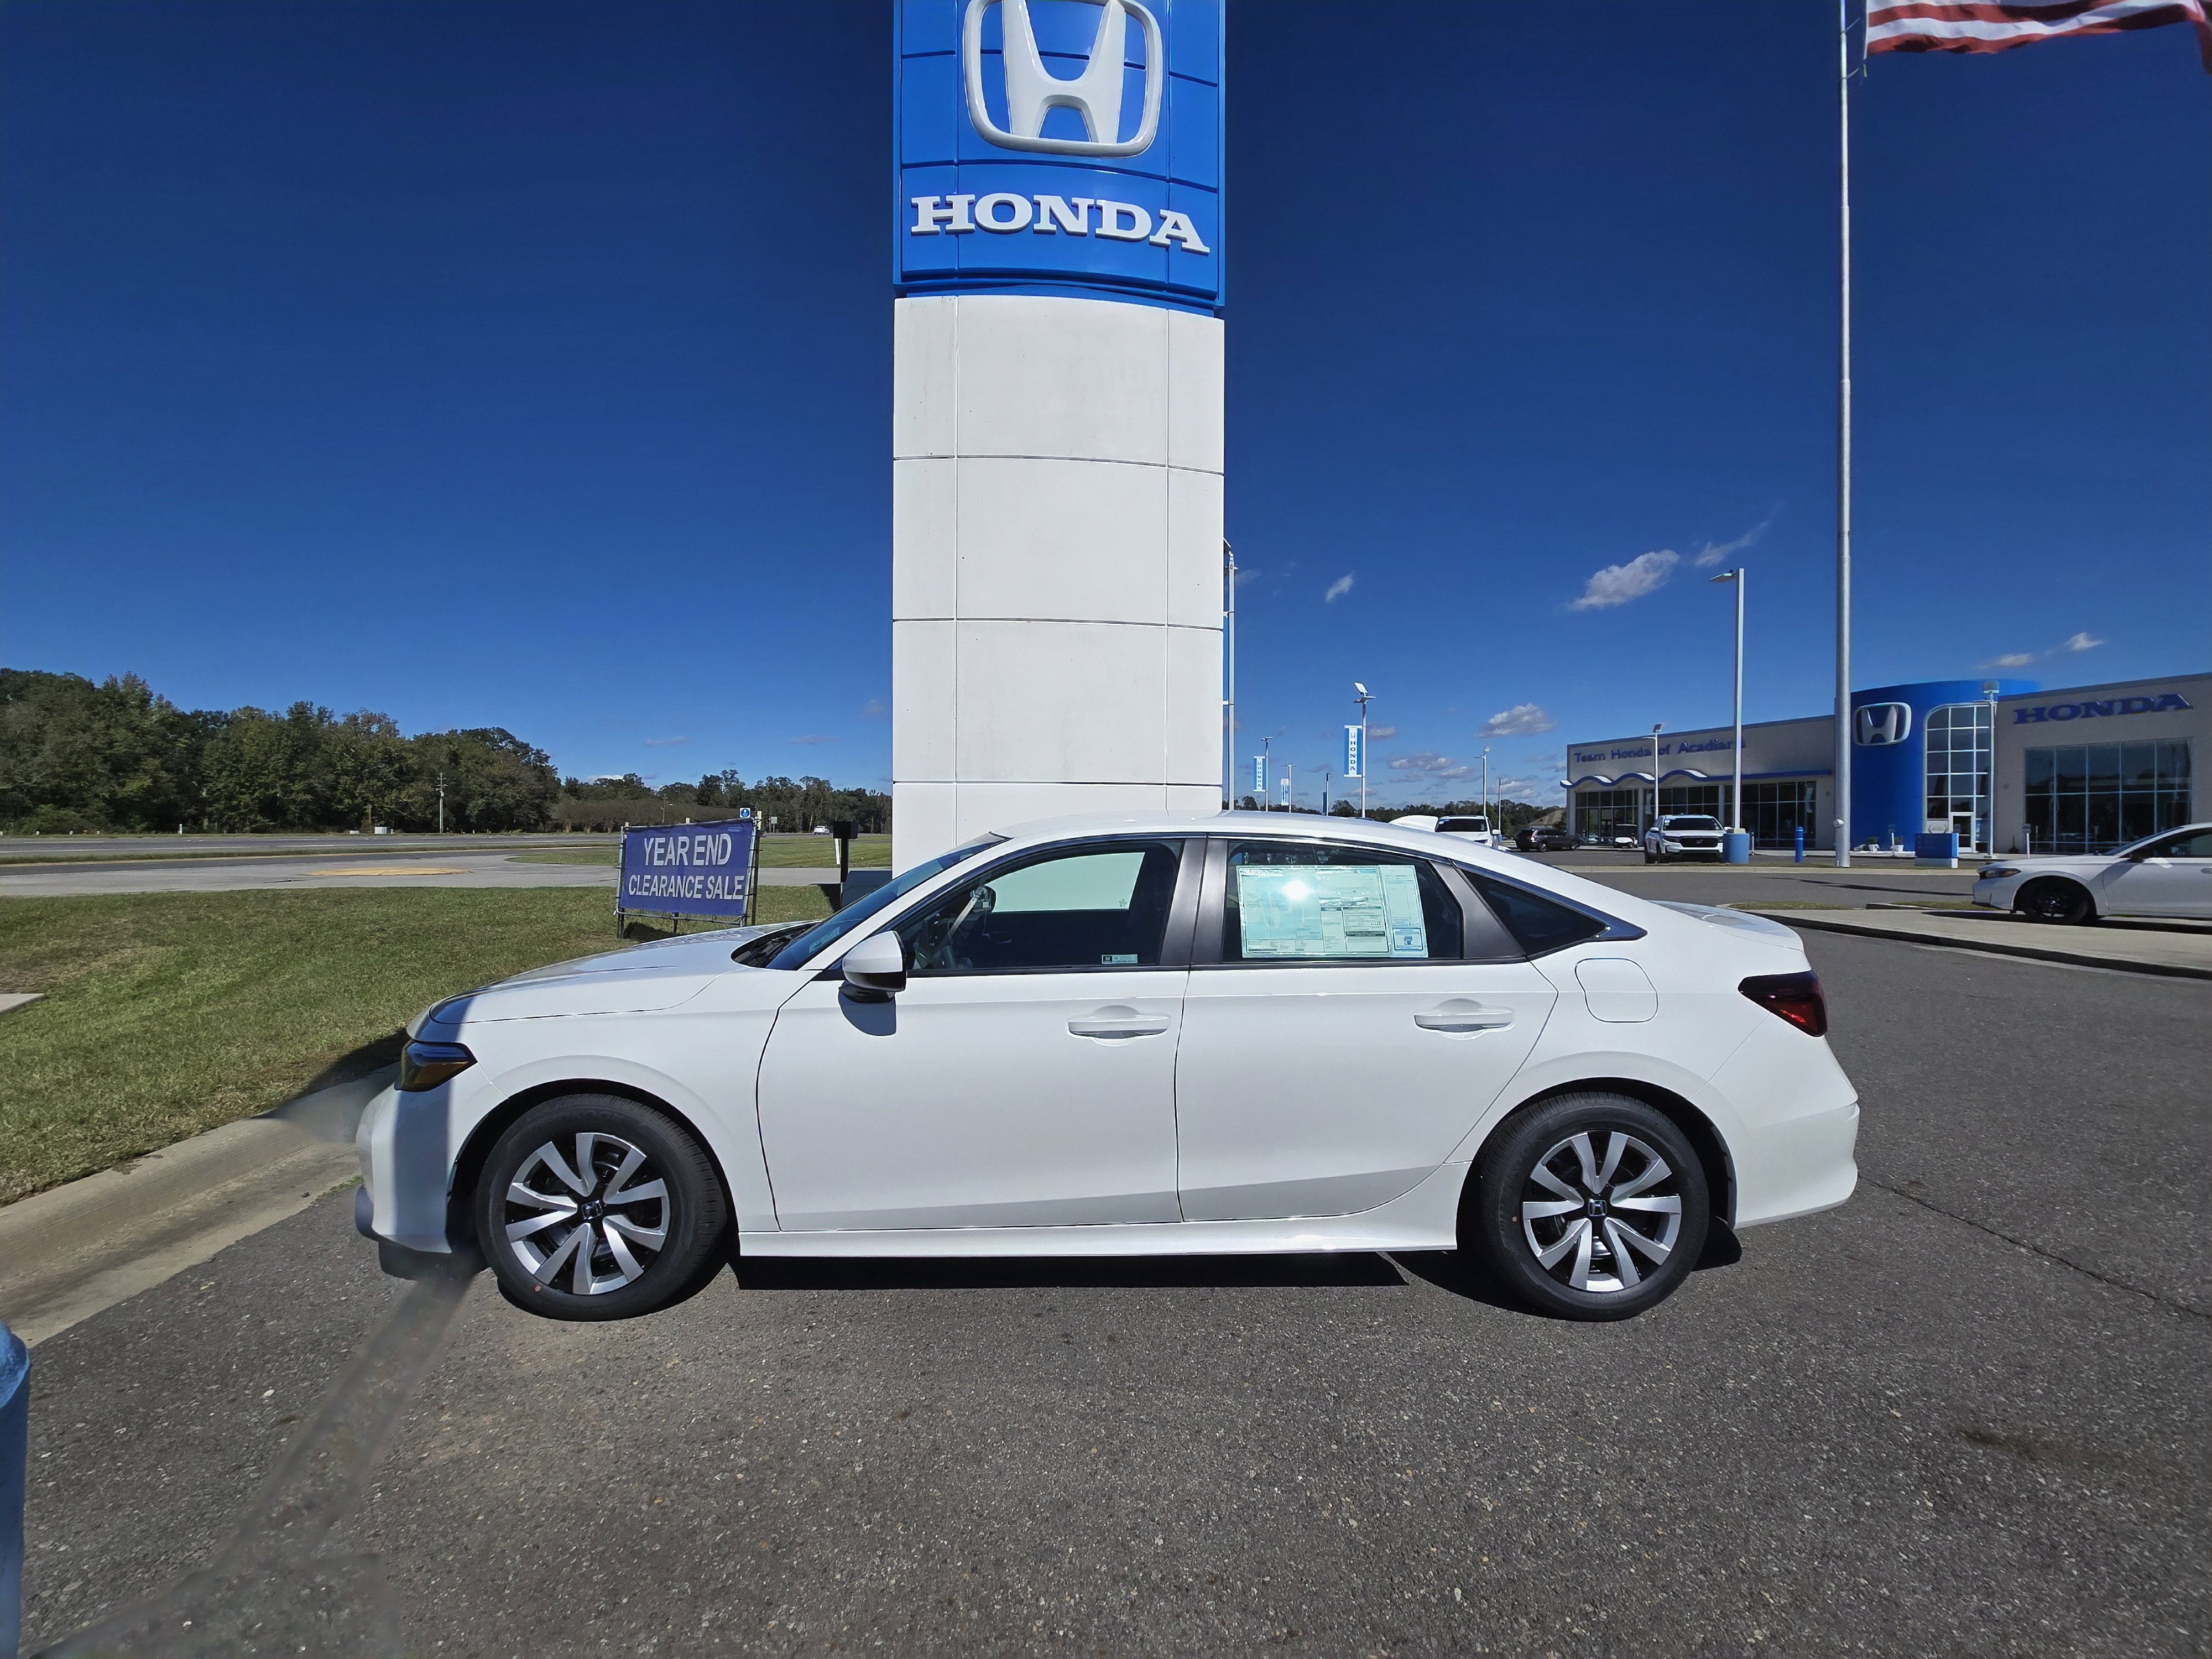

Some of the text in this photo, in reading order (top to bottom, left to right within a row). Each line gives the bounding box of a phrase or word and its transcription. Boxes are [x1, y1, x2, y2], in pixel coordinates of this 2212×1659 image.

[911, 192, 1210, 255] HONDA
[2013, 693, 2194, 724] HONDA
[1573, 752, 1606, 763] Team
[1610, 747, 1652, 760] Honda
[1657, 743, 1671, 756] of
[644, 833, 732, 866] YEAR END
[628, 874, 744, 900] CLEARANCE SALE
